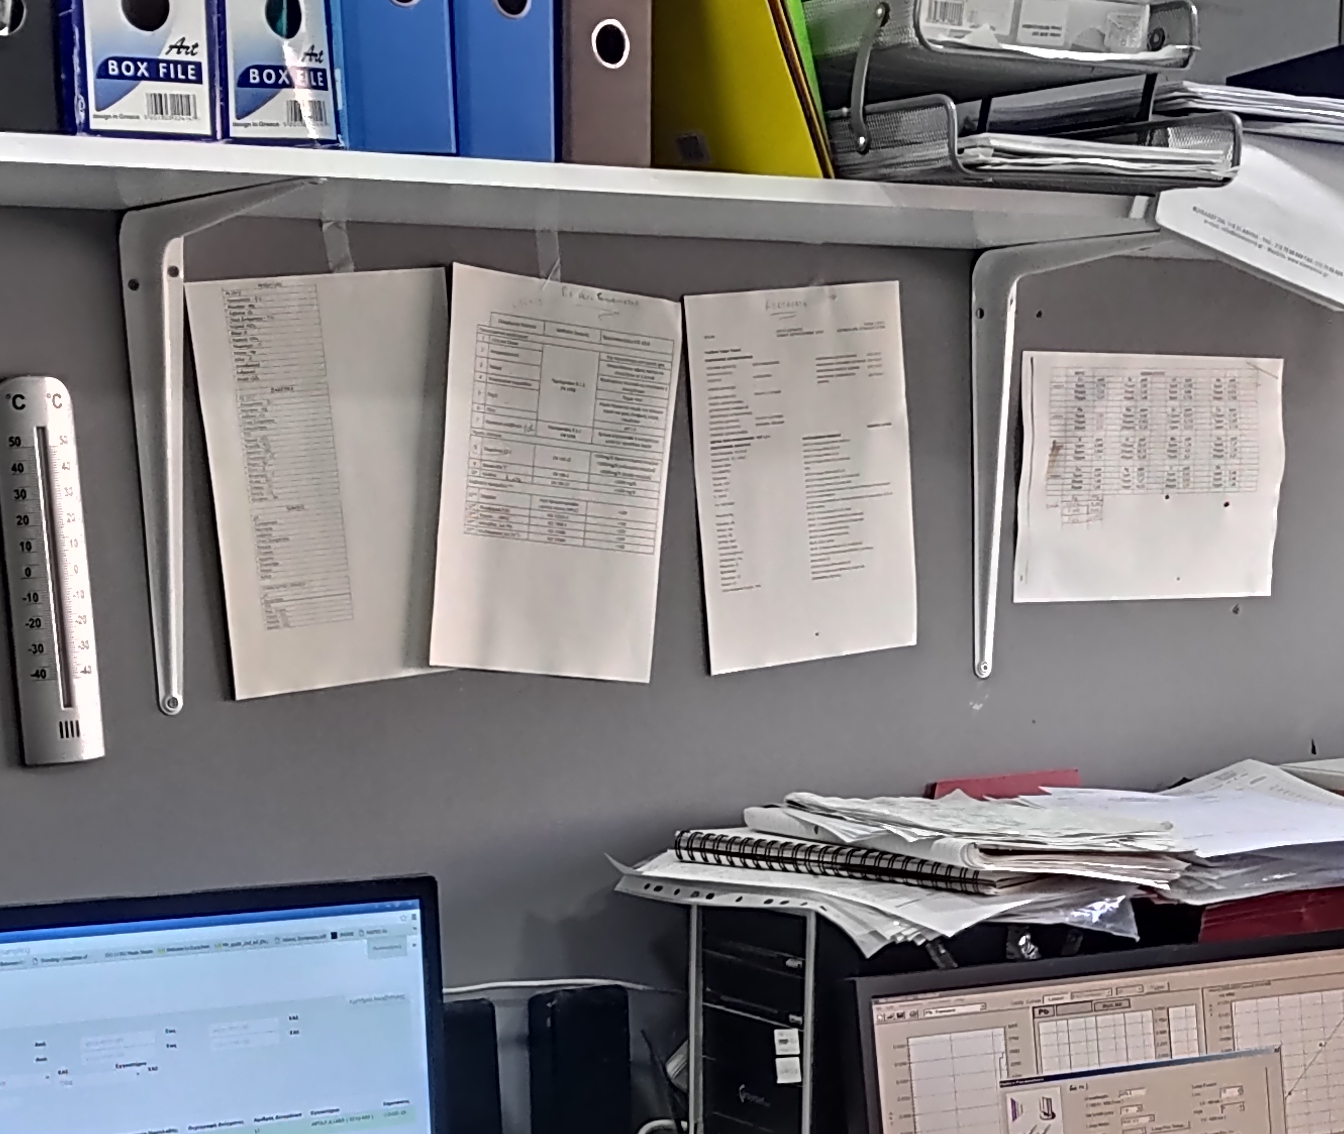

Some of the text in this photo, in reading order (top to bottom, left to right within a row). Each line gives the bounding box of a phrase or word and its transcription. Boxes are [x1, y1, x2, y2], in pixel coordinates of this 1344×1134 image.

[165, 37, 199, 57] Art
[107, 59, 197, 80] BOX FILE
[249, 67, 291, 85] BOX
[8, 436, 22, 448] 50
[11, 462, 25, 474] 40
[13, 489, 27, 500] 30
[16, 515, 30, 526] 20
[19, 541, 32, 552] 10
[24, 567, 32, 578] 0
[22, 592, 40, 603] -10
[25, 617, 42, 629] -20
[27, 643, 45, 654] -30
[30, 668, 47, 679] -40
